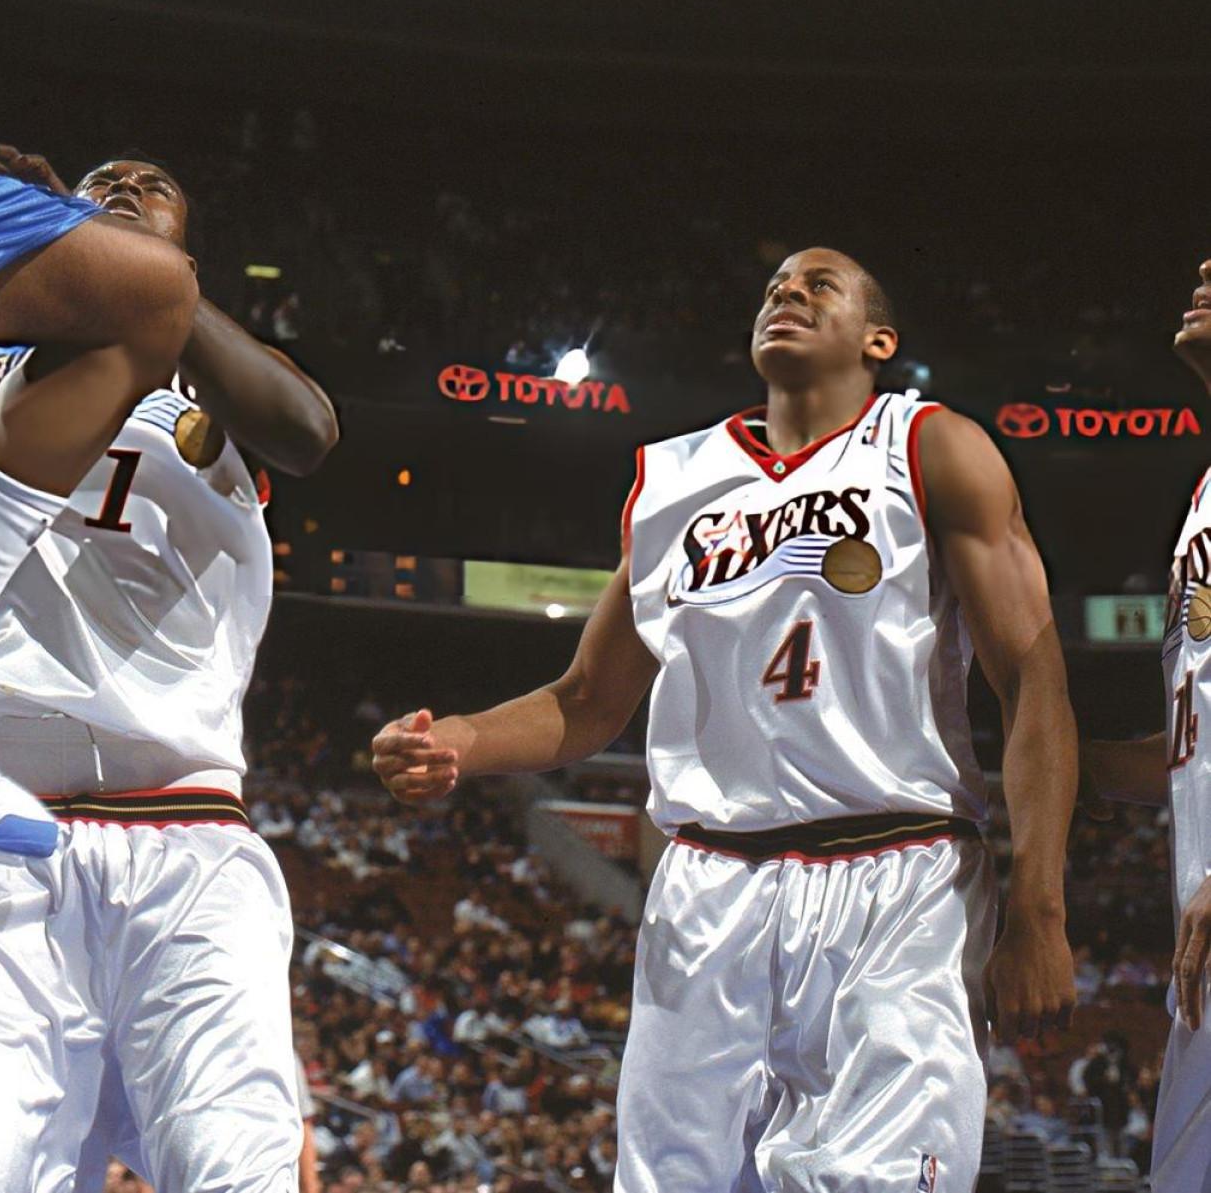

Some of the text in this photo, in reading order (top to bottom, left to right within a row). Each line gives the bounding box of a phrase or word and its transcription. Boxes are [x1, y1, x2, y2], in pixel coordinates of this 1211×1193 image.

[495, 372, 631, 413] TOYOTA
[1055, 407, 1201, 437] TOYOTA
[84, 448, 142, 533] 1
[683, 487, 870, 591] SIXERS
[761, 619, 821, 704] 4
